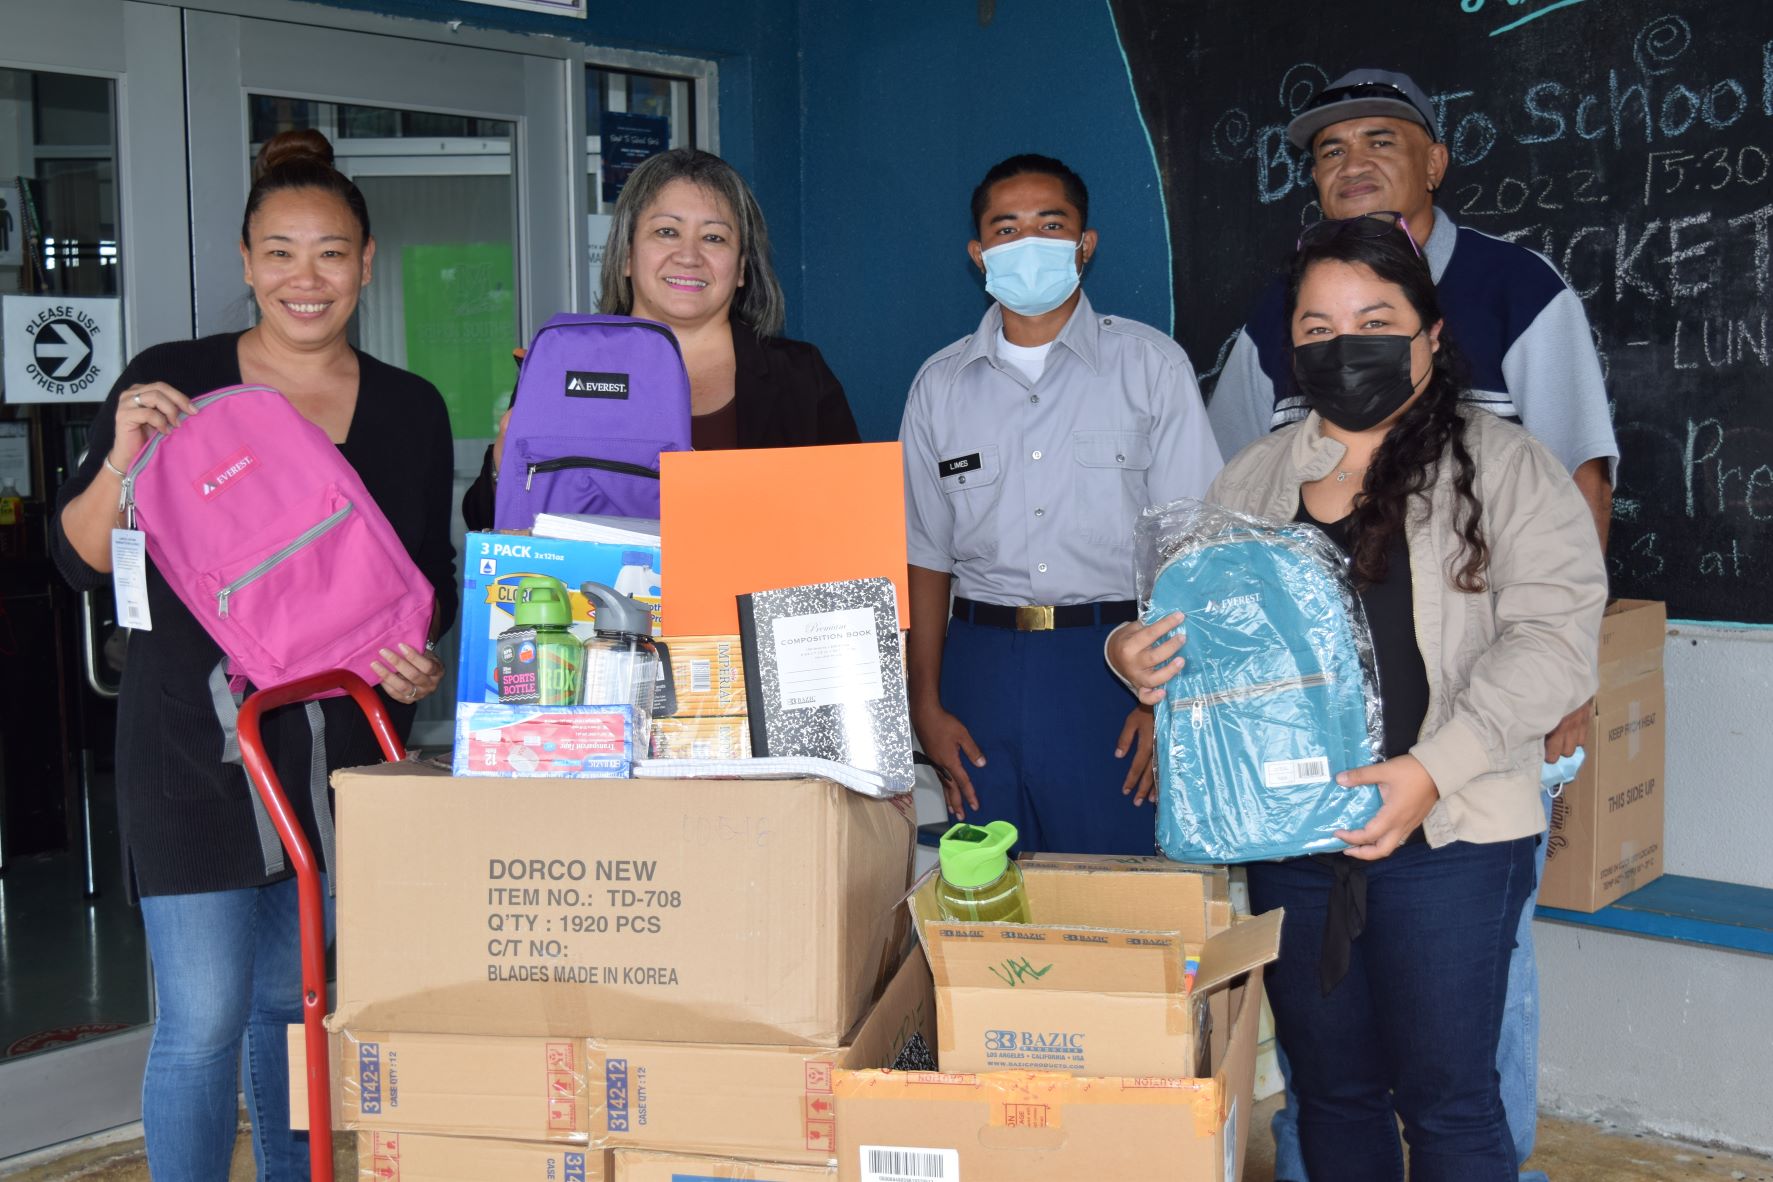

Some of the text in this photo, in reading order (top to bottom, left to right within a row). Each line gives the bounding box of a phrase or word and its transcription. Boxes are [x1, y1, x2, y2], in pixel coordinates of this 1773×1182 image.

[25, 306, 100, 337] PLEASE USE
[26, 363, 101, 395] OTHER DOOR
[586, 382, 626, 392] EVEREST
[216, 455, 253, 485] EVEREST
[950, 459, 968, 470] LIMES
[480, 542, 490, 555] 3
[493, 544, 532, 558] PACK
[781, 630, 872, 646] COMPOSITION BOOK
[503, 673, 535, 684] SPORTS
[719, 644, 730, 704] IMPERIAL
[504, 683, 536, 695] BOTTLE
[1608, 725, 1623, 742] KEEP
[1641, 712, 1656, 730] HEAT
[1608, 778, 1655, 813] THIS SIDE UP
[489, 859, 657, 881] DORCO NEW
[488, 888, 540, 906] ITEM
[607, 889, 681, 908] TD-708
[560, 915, 609, 933] 1920
[616, 915, 661, 933] PCS
[488, 939, 568, 957] C/T NO:
[488, 964, 679, 985] BLADES MADE IN KOREA
[988, 957, 1053, 987] VAL
[1020, 1031, 1083, 1048] BAZIC
[362, 1045, 380, 1112] 3142-12
[389, 1069, 397, 1085] QTY
[390, 1087, 398, 1107] CASE
[608, 1061, 627, 1129] 3142-12
[638, 1086, 647, 1102] QTY
[638, 1103, 647, 1126] CASE
[547, 1158, 556, 1181] CASE
